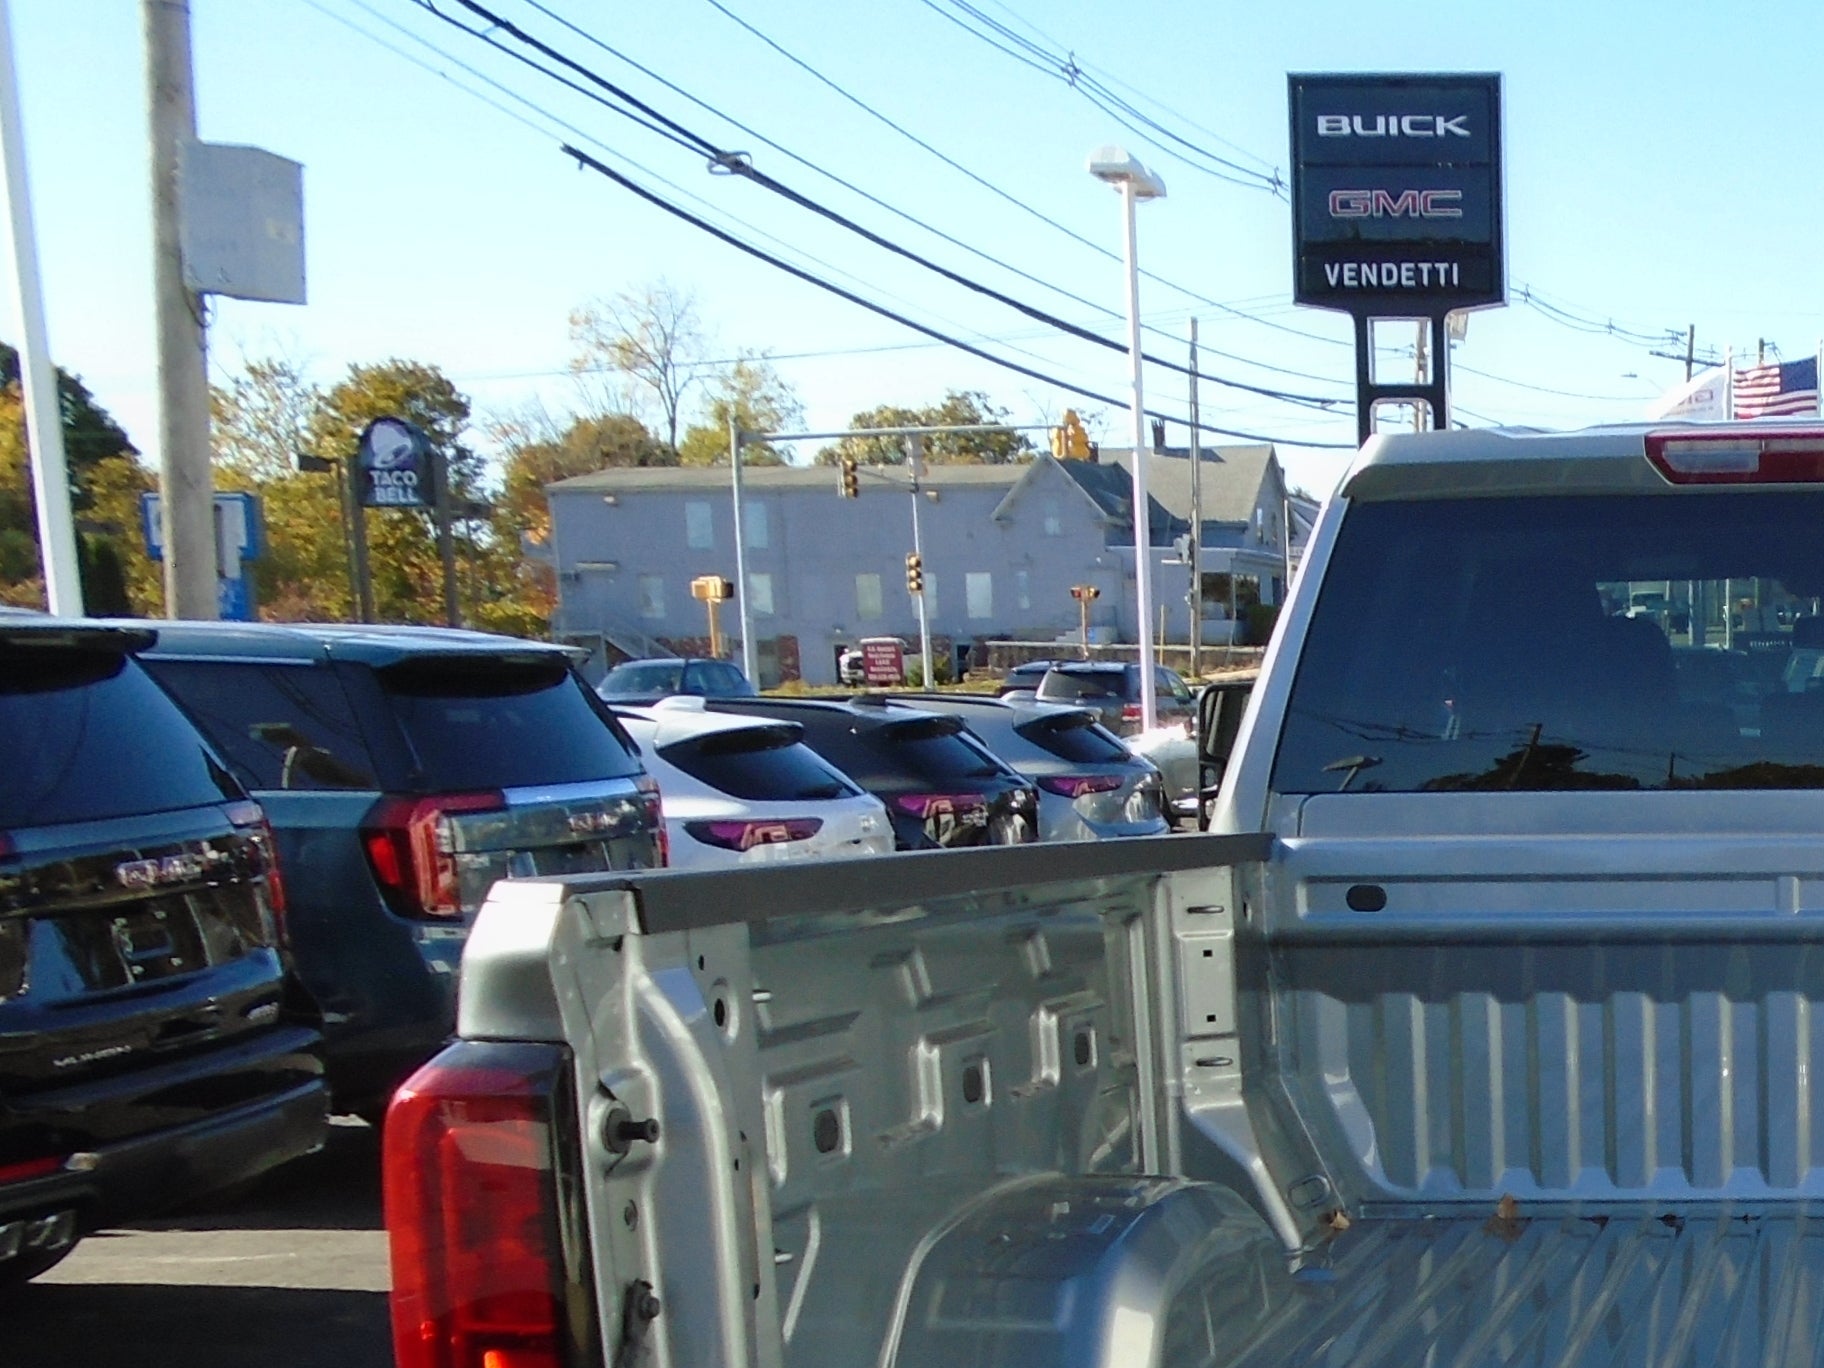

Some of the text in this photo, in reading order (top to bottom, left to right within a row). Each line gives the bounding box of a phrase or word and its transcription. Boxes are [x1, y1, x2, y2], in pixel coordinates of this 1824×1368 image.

[1316, 115, 1471, 137] BUICK
[1328, 189, 1463, 218] GMC
[1324, 262, 1460, 288] VENDETTI
[369, 470, 418, 487] TACO
[374, 487, 420, 503] BELL
